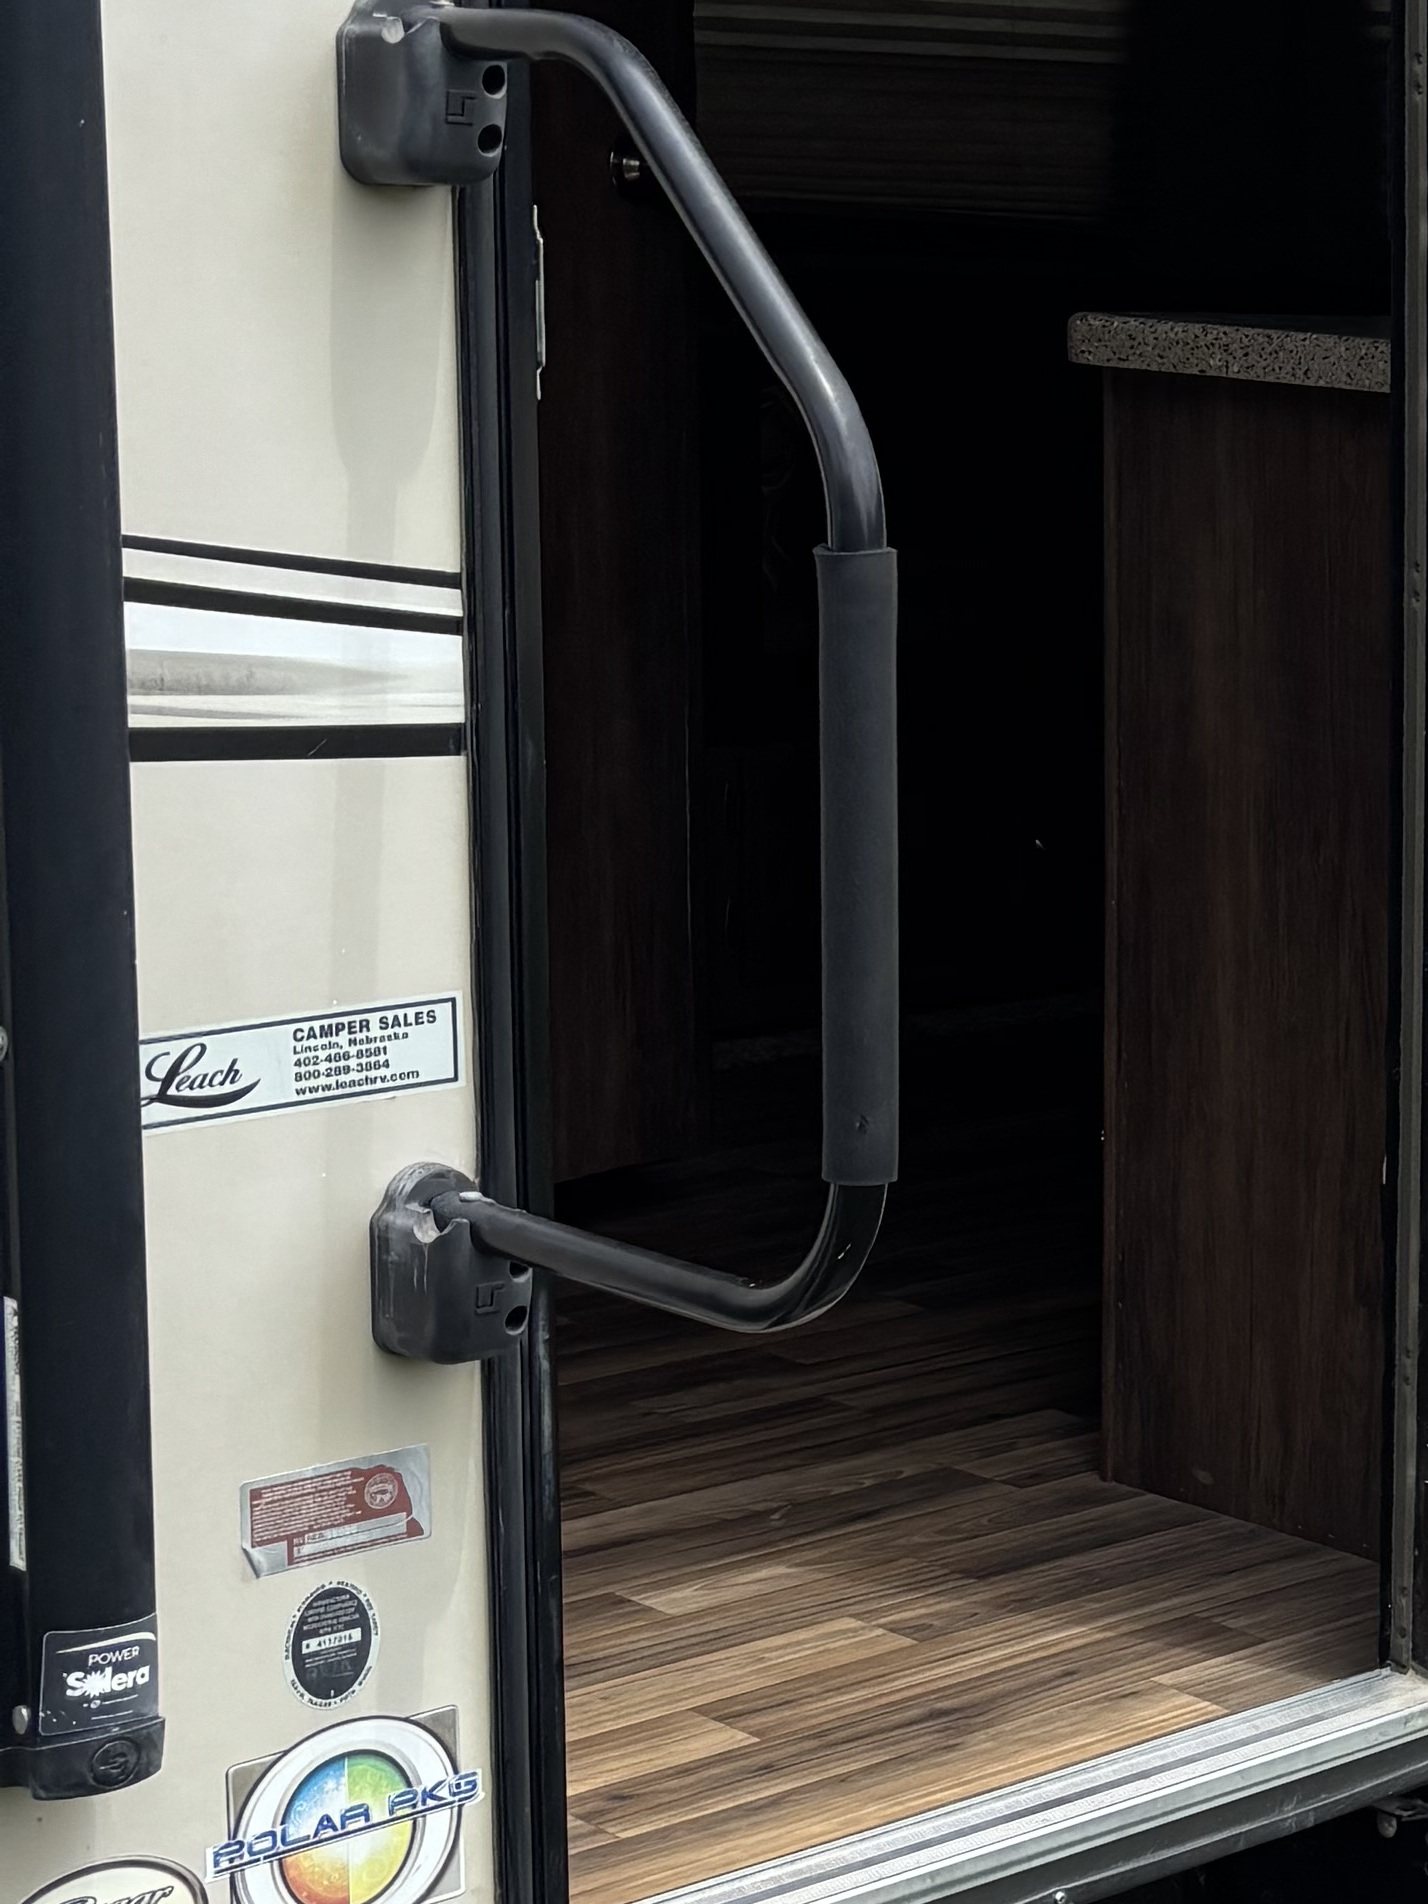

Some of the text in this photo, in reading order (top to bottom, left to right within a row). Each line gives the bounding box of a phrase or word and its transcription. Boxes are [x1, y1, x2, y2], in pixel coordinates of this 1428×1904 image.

[293, 1009, 437, 1043] CAMPER SALES
[293, 1041, 343, 1055] Lincoln,
[141, 1043, 261, 1108] Leach
[88, 1646, 140, 1667] POWER
[212, 1770, 480, 1869] POLAR PKG
